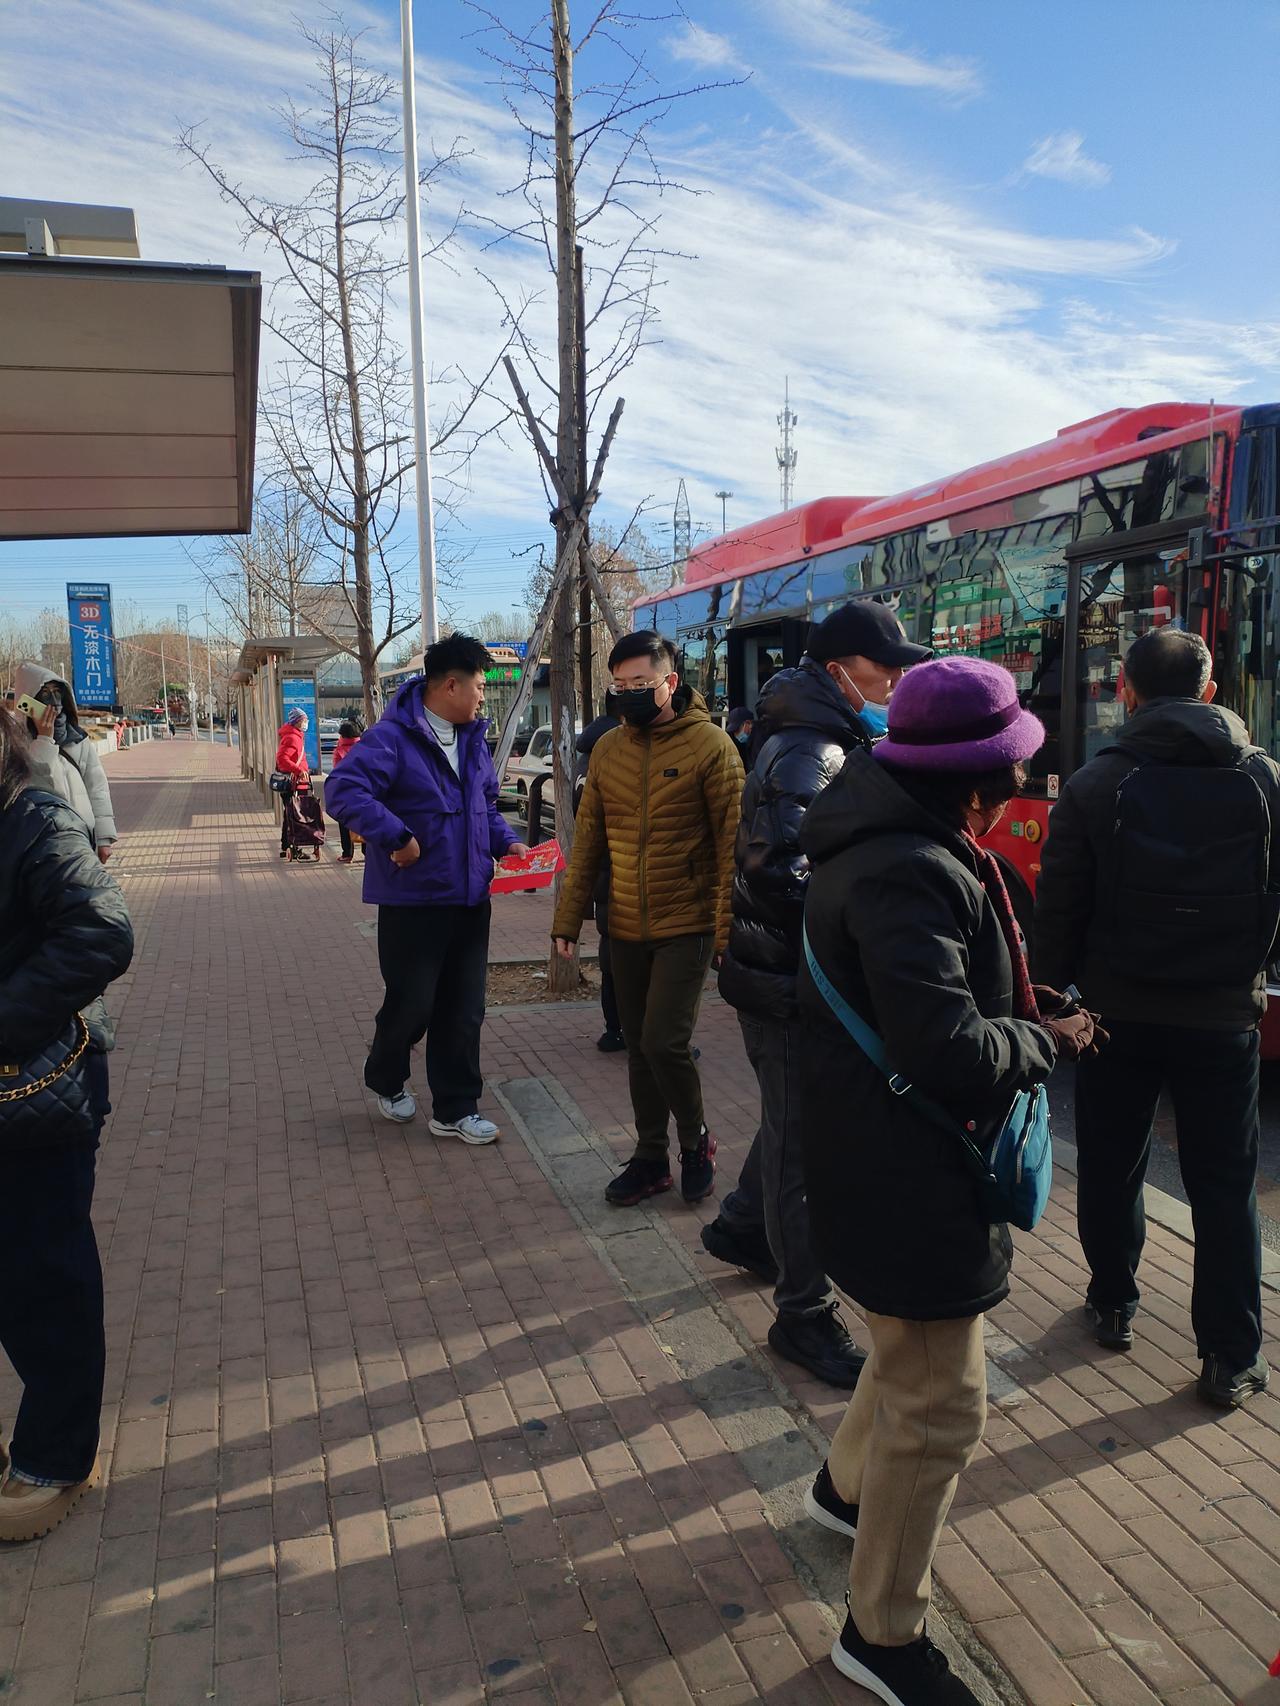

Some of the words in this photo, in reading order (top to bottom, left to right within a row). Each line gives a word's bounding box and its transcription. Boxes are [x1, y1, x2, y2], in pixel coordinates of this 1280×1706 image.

[81, 607, 99, 618] 3D
[84, 625, 101, 686] 无漆木门
